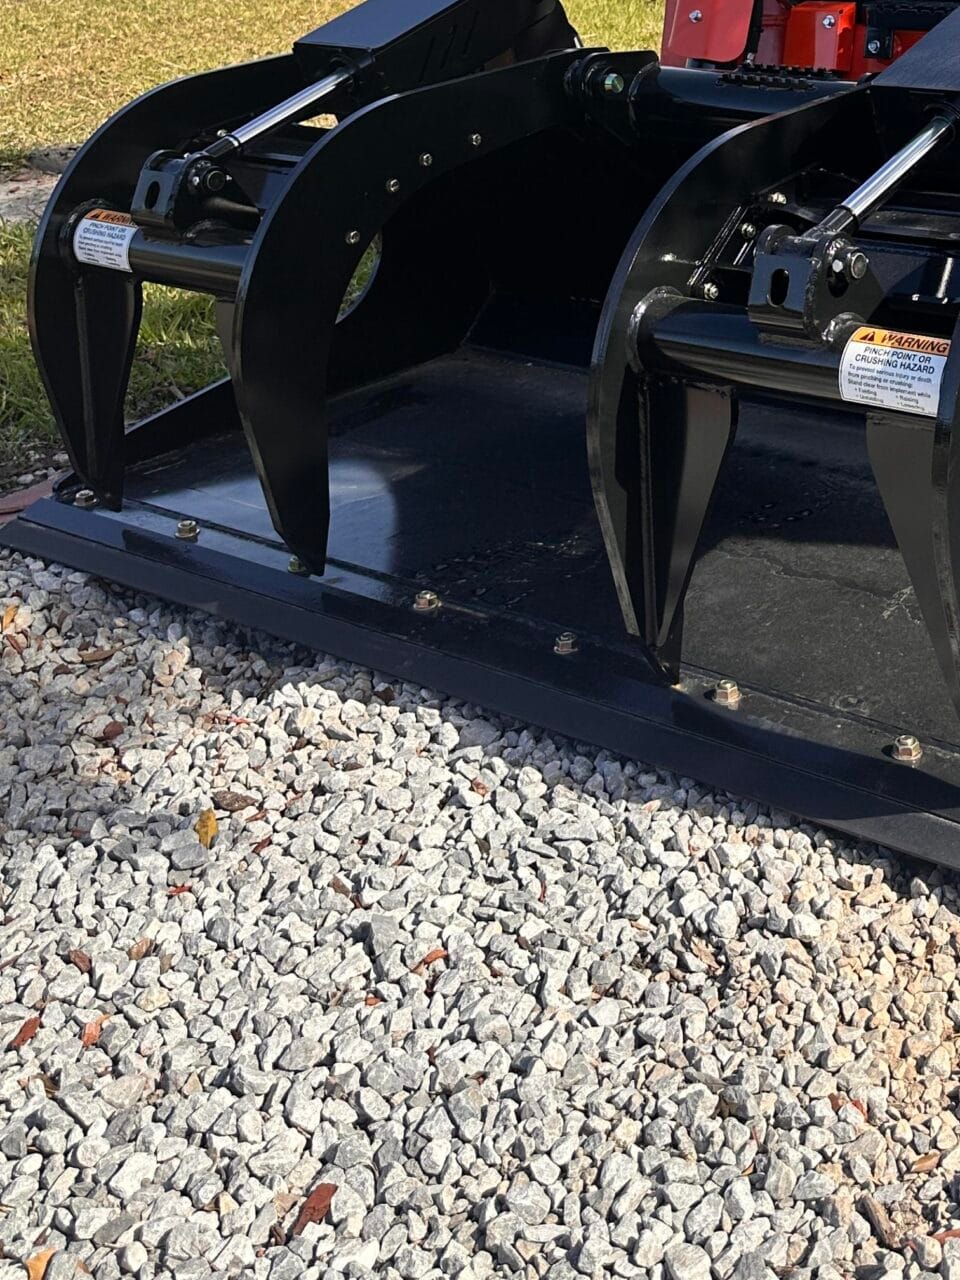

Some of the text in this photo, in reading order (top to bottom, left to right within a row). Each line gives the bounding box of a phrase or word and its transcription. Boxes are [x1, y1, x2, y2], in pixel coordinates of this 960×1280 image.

[881, 331, 949, 354] WARNING
[855, 353, 935, 375] CRUSHING HAZARD
[864, 346, 931, 363] PINCH POINT OR
